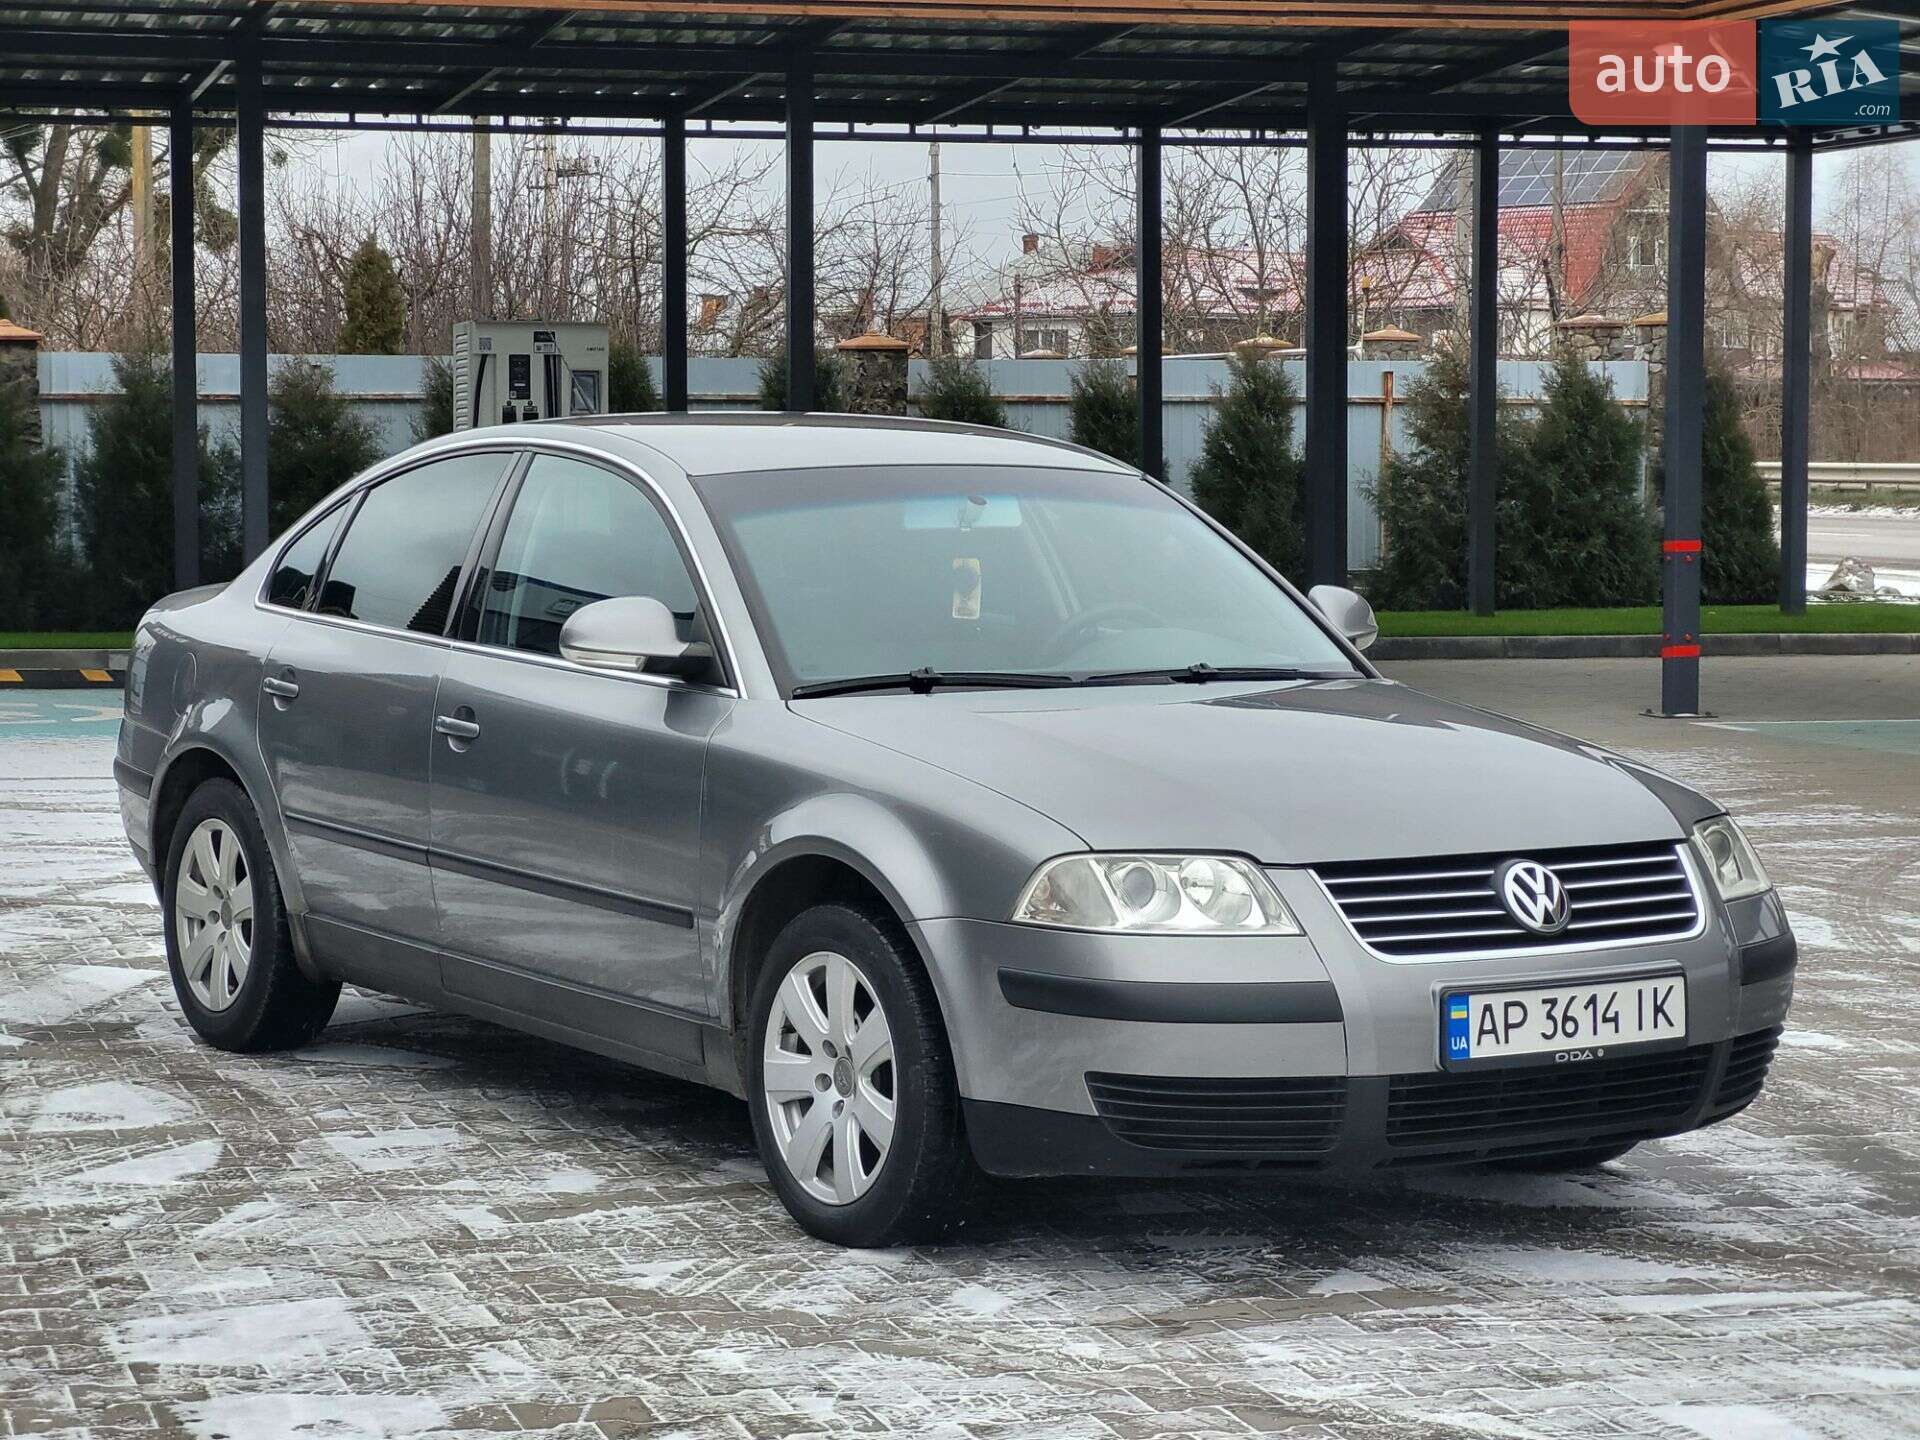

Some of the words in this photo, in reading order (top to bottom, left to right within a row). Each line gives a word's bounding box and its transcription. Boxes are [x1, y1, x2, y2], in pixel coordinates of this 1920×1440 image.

[1476, 1000, 1528, 1046] AP
[1540, 991, 1620, 1040] 3614
[1637, 985, 1675, 1031] IK
[1451, 1037, 1468, 1051] UA
